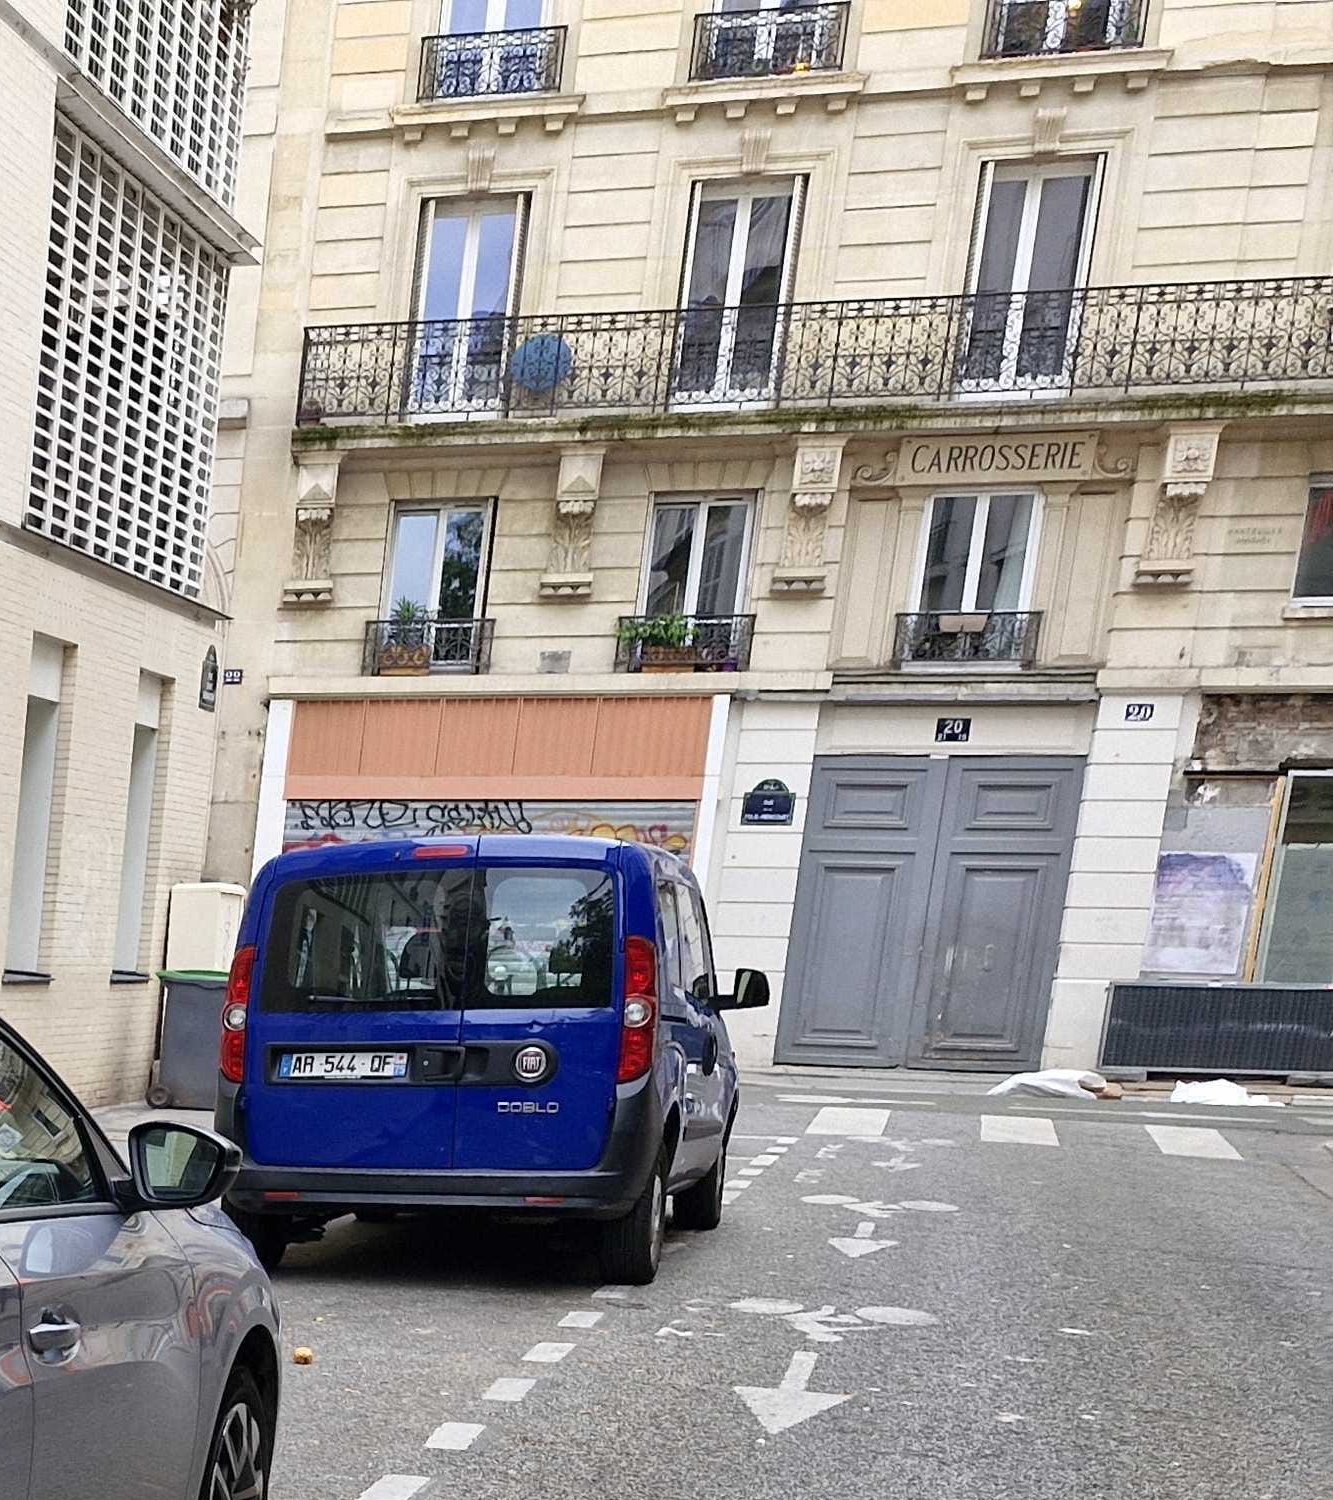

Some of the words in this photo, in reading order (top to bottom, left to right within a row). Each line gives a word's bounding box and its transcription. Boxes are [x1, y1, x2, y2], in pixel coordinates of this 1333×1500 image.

[911, 441, 1086, 474] CARROSSERIE
[1128, 705, 1152, 720] 20
[943, 720, 963, 734] 20
[522, 1056, 541, 1070] FIAT
[497, 1102, 559, 1113] DOBLO
